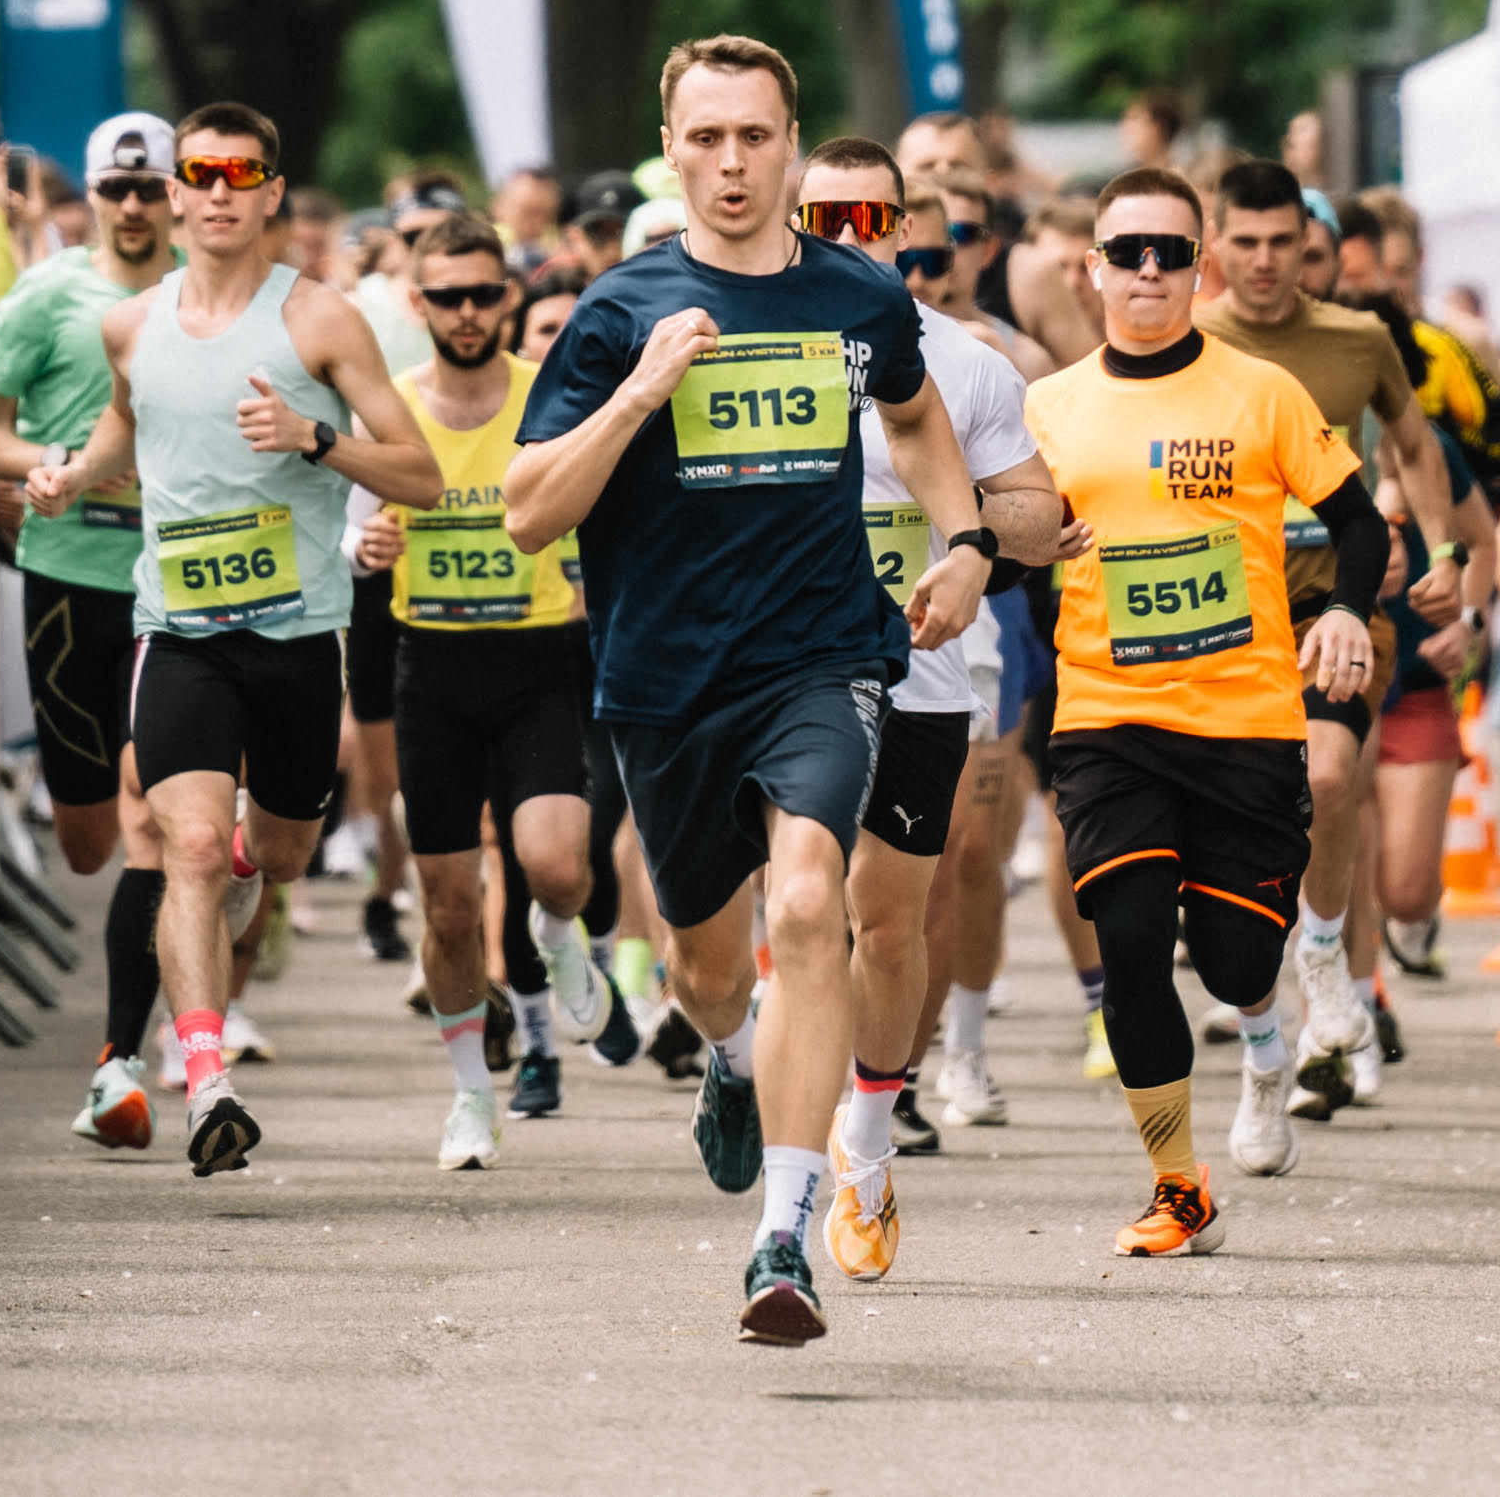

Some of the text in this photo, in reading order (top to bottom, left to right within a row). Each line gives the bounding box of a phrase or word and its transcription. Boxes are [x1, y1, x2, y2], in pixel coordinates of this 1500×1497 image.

[840, 337, 873, 368] HP
[708, 386, 818, 430] 5113
[1168, 439, 1235, 458] MHP
[1167, 459, 1233, 481] RUN
[1167, 484, 1234, 500] TEAM
[181, 546, 277, 590] 5136
[428, 549, 516, 579] 5123
[1127, 570, 1228, 617] 5514
